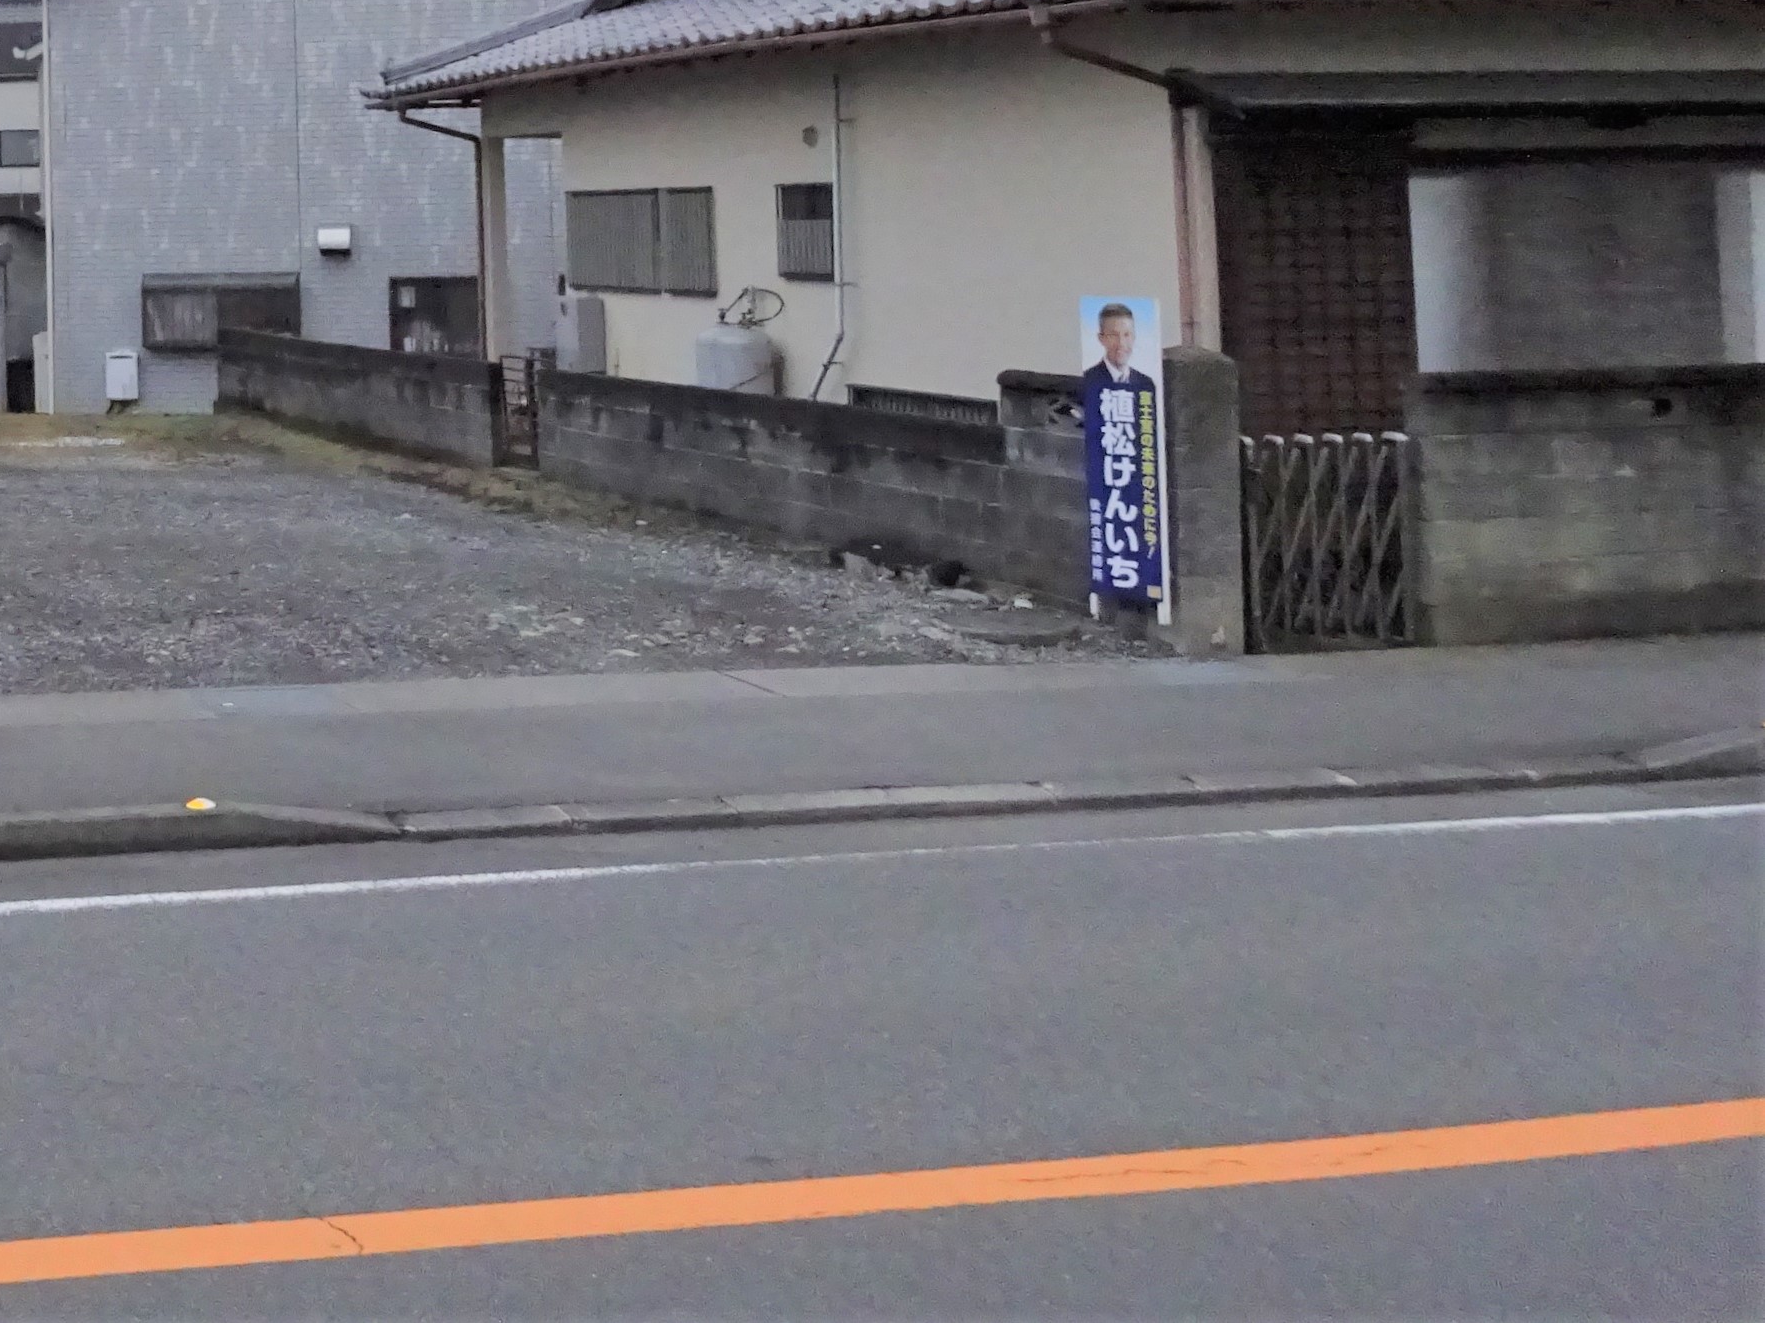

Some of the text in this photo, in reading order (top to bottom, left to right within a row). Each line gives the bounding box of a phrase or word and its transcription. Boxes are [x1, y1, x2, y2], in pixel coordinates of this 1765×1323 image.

[1099, 388, 1139, 588] 植松けんいち
